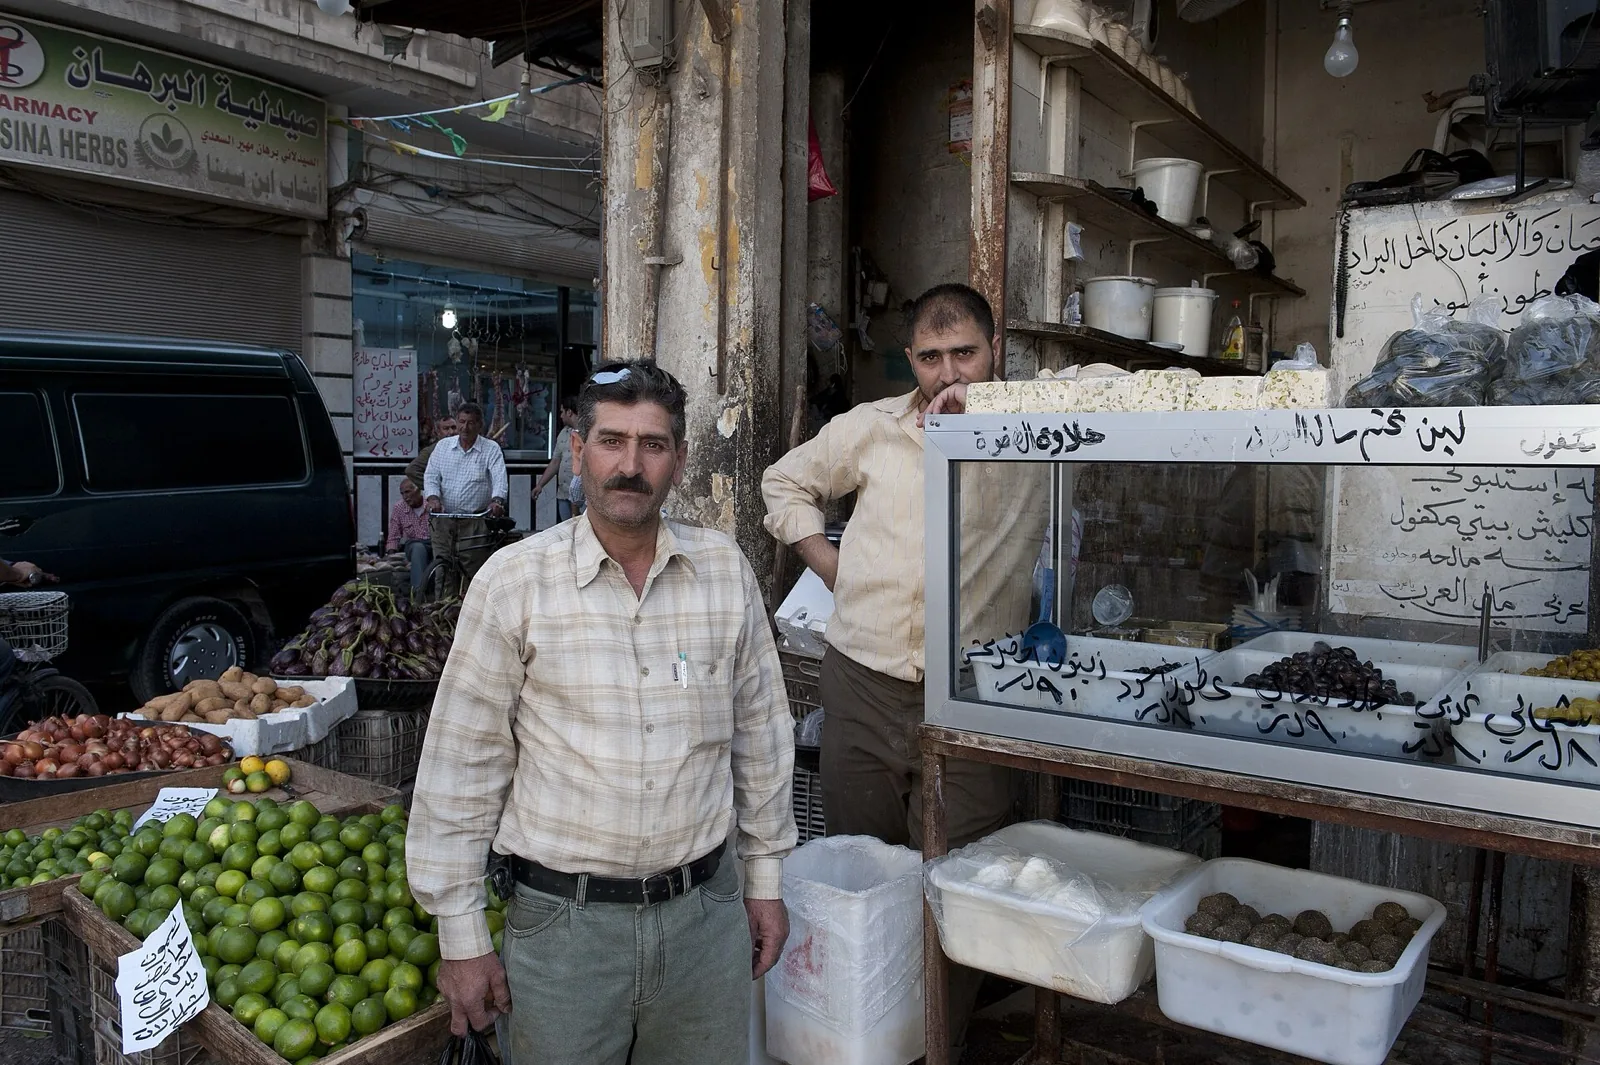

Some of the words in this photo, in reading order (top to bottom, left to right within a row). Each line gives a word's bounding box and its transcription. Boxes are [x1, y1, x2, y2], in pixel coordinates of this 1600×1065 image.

[66, 46, 206, 111] البرهان
[213, 73, 319, 139] صيدلية
[0, 117, 53, 156] SINA
[59, 128, 128, 168] HERBS
[200, 130, 234, 145] السعدي
[1347, 235, 1397, 275] البراد
